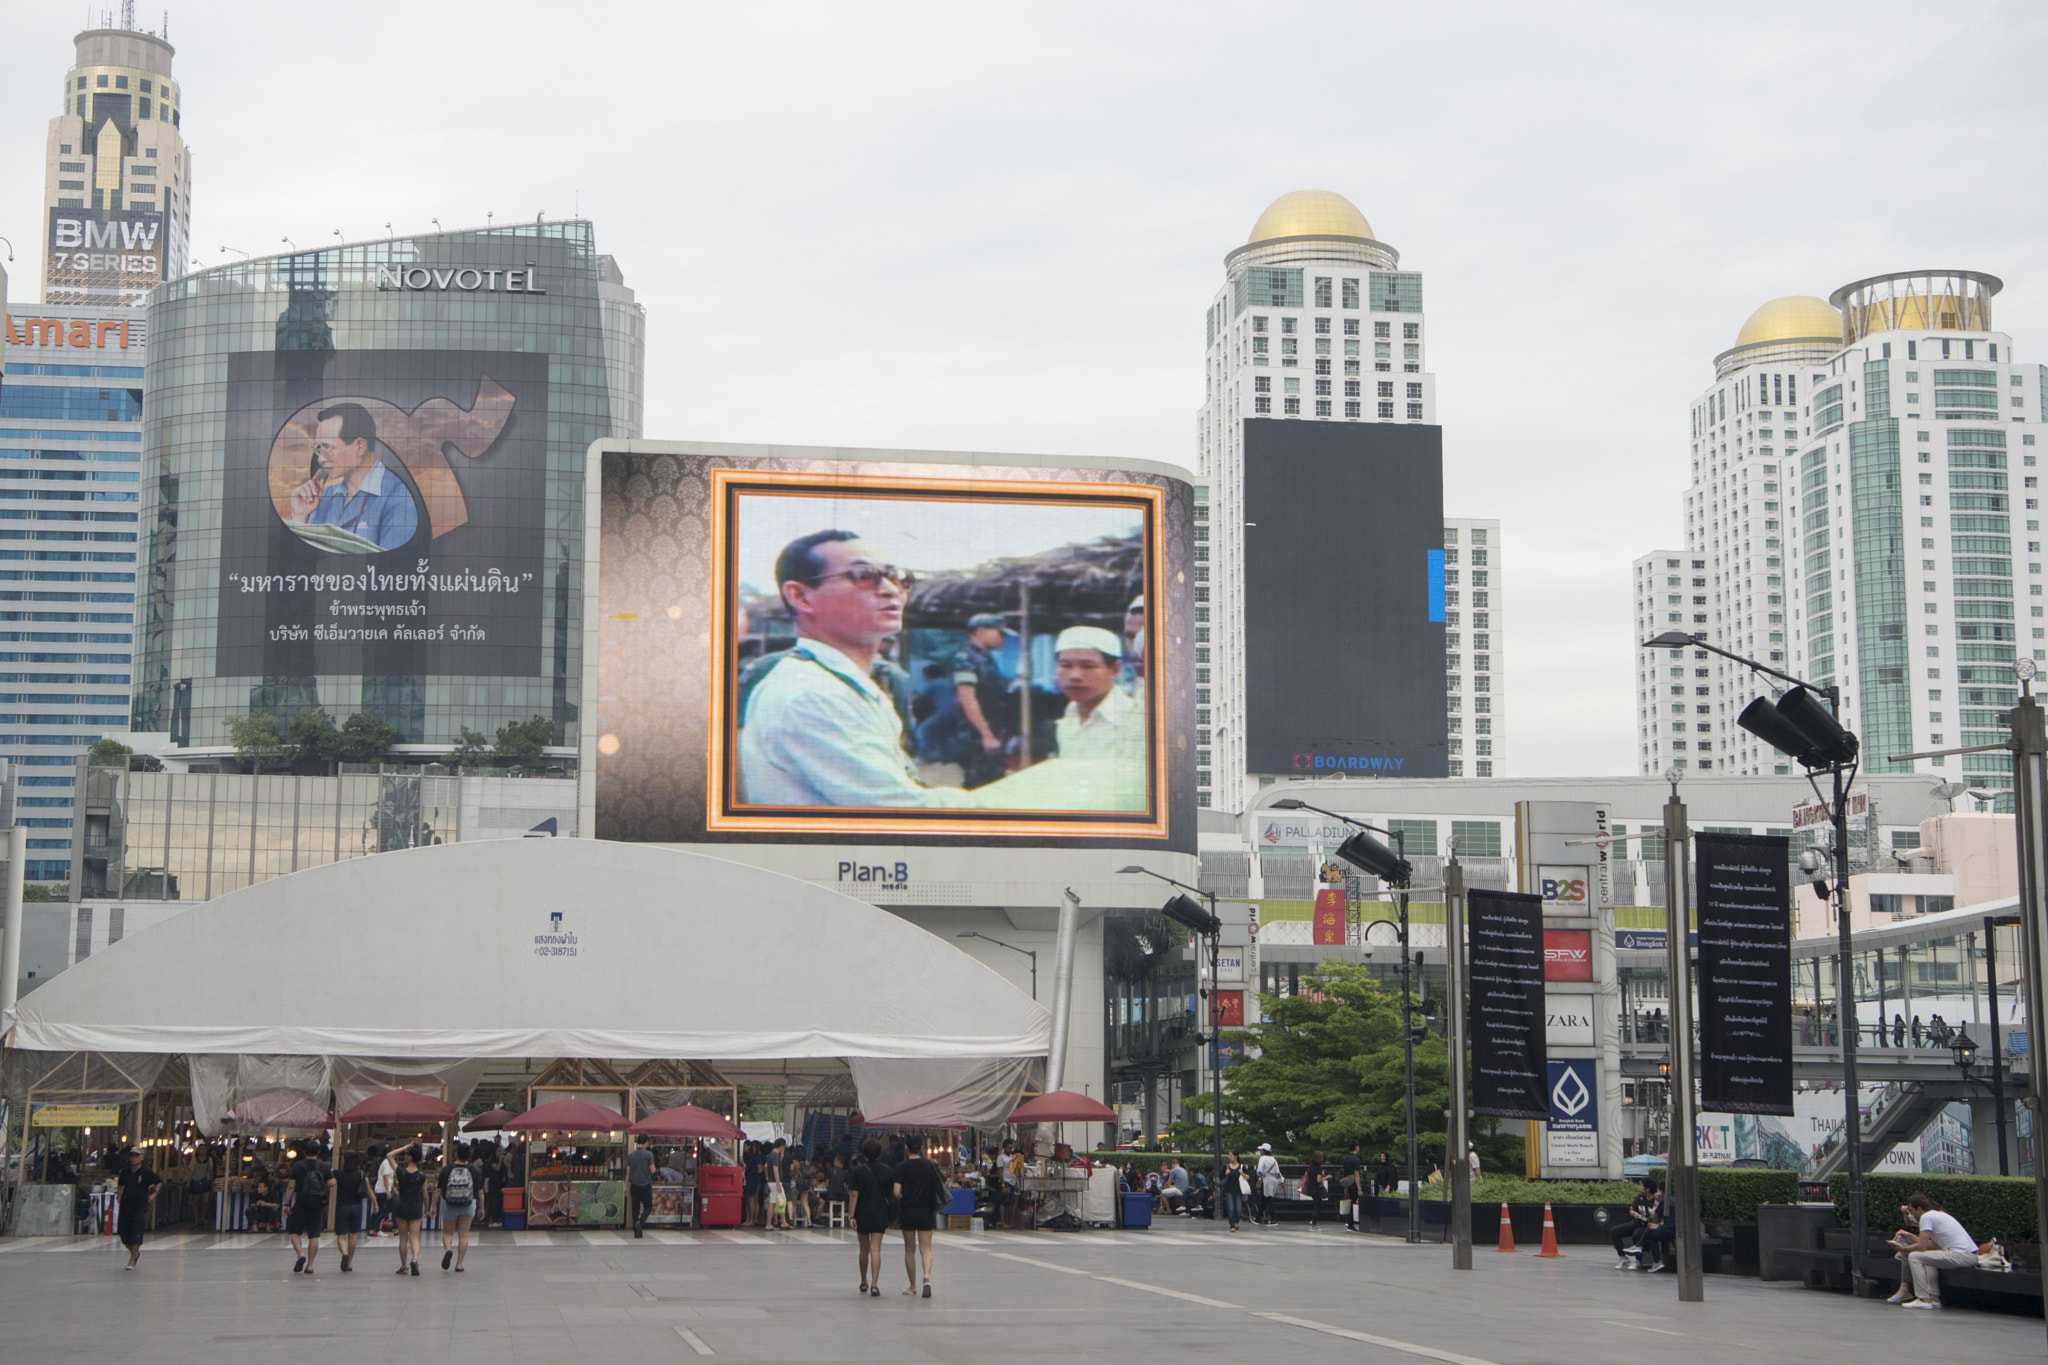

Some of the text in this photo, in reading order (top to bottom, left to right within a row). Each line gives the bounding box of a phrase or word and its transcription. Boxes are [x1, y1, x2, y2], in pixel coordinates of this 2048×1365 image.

[56, 218, 159, 250] BMW
[54, 252, 158, 273] 7 SERIES
[376, 263, 547, 295] NOVOTEL
[329, 599, 426, 621] ข้าพระพุทธเจ้า
[269, 622, 309, 641] บริษัท
[449, 623, 486, 641] จำกัด
[1314, 755, 1404, 770] BOARDWAY
[1285, 826, 1355, 838] PALLADIUM
[1542, 879, 1586, 902] B2S
[539, 947, 578, 957] 02-3187151
[1216, 958, 1241, 968] SETAN
[1546, 1014, 1590, 1027] ZARA
[1810, 1117, 1847, 1132] THAILA
[1696, 1125, 1730, 1150] RKET
